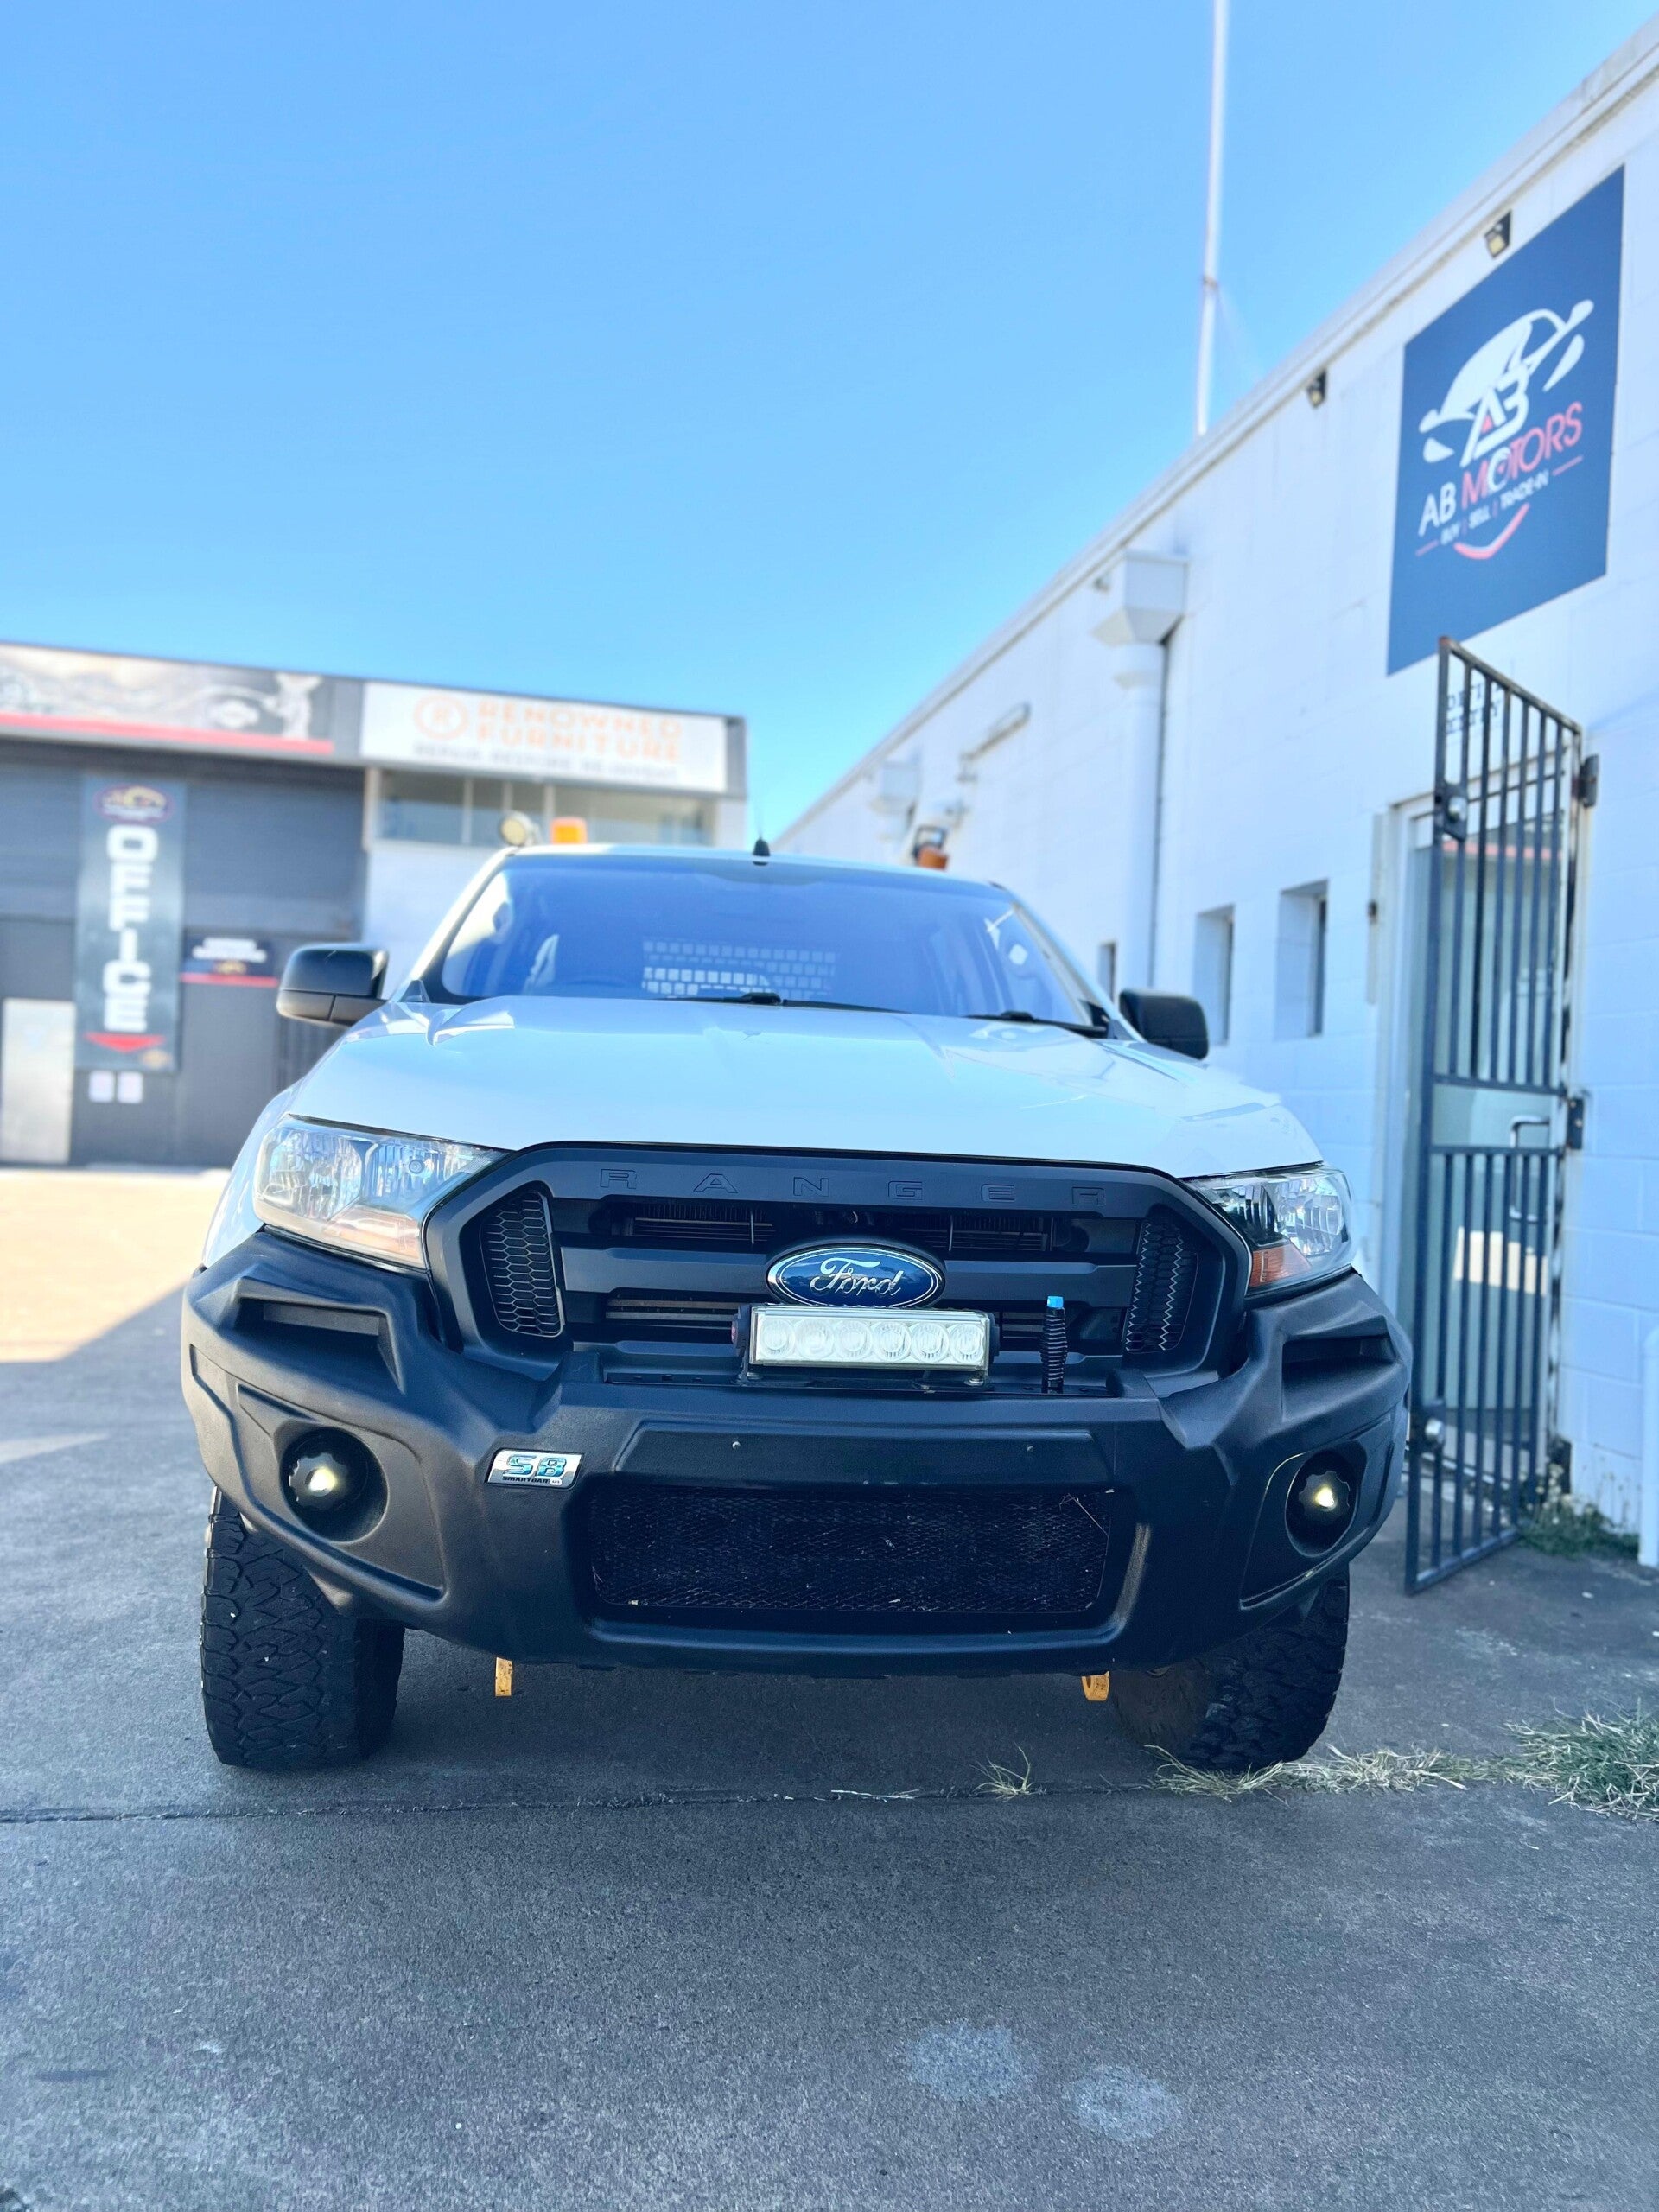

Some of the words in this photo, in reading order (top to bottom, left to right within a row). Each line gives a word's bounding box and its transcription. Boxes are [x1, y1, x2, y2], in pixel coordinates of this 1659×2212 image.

[1418, 481, 1457, 537] AB
[1461, 401, 1583, 512] MOTORS
[477, 699, 683, 741] RENOWNED
[477, 721, 683, 762] FURNITURE
[103, 823, 159, 1033] OFFICE
[600, 1168, 1107, 1207] RANGER
[810, 1257, 904, 1296] Ford
